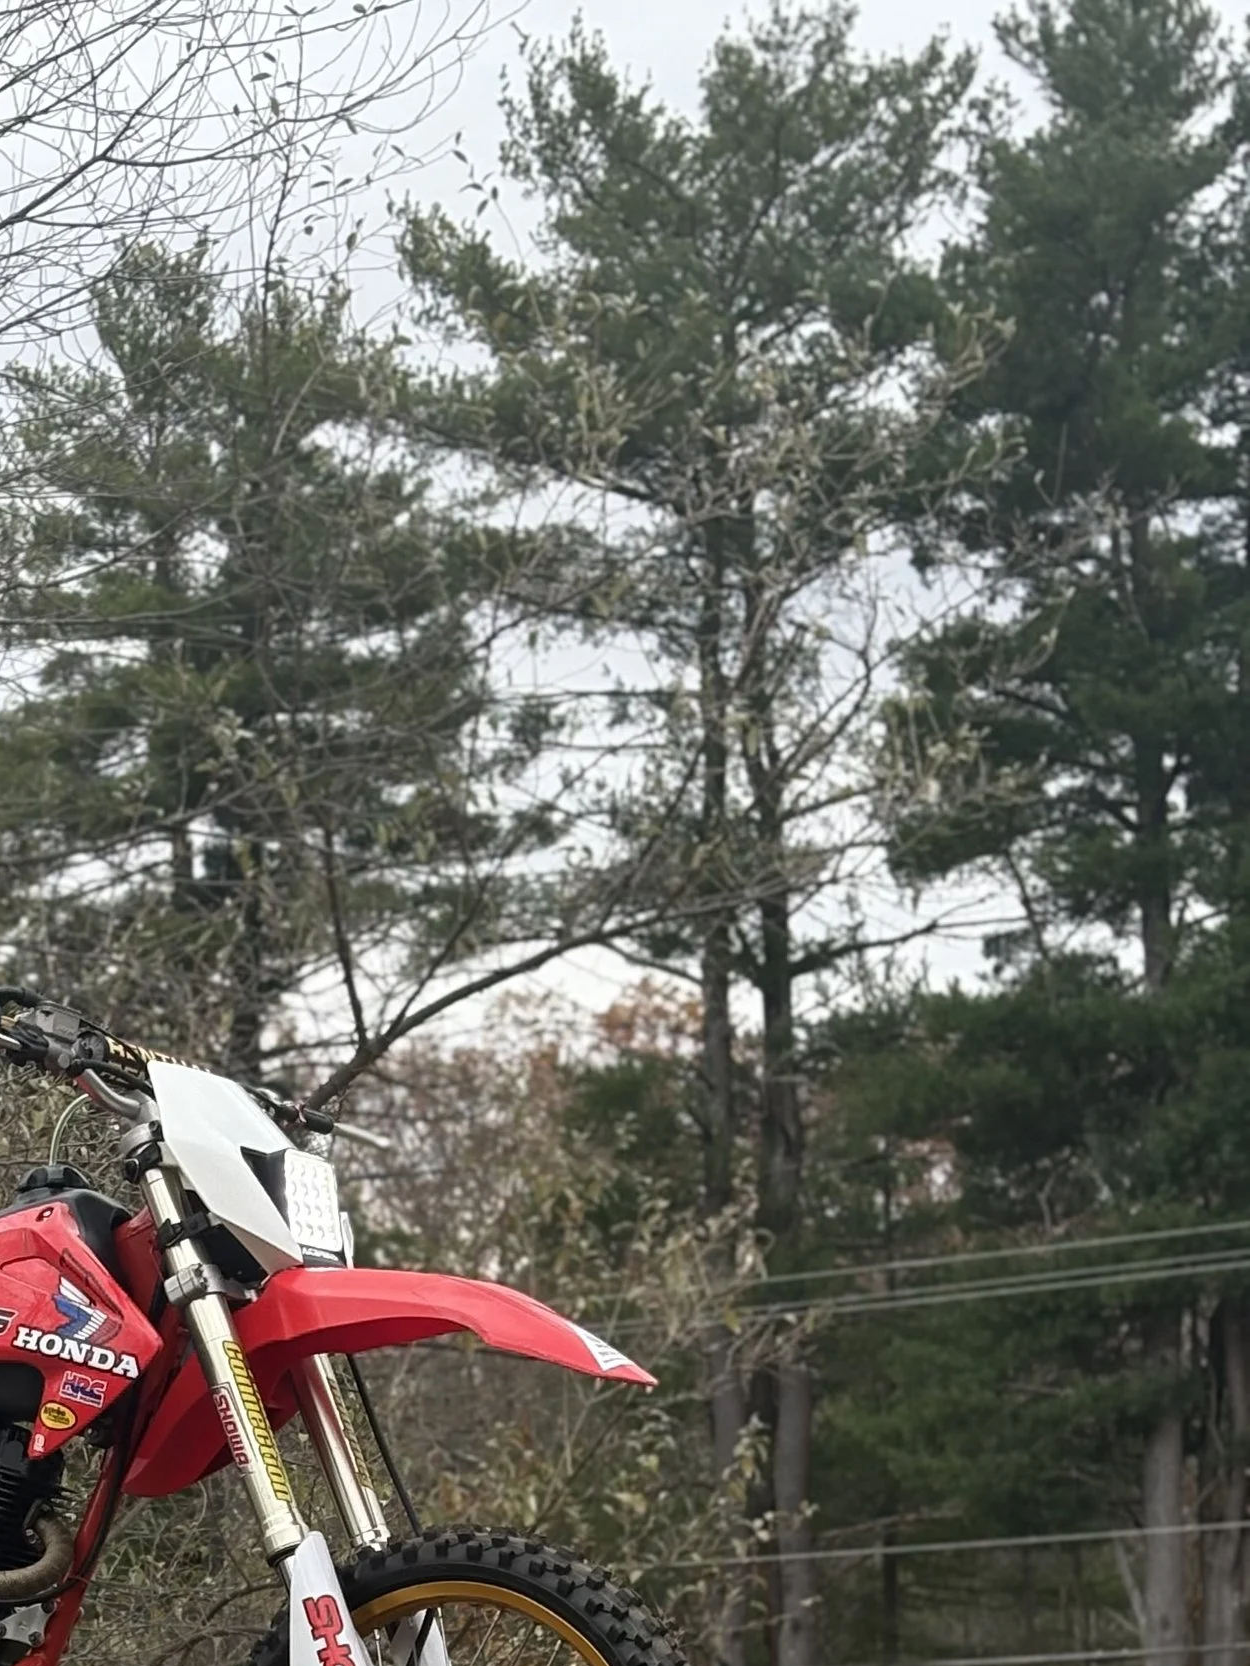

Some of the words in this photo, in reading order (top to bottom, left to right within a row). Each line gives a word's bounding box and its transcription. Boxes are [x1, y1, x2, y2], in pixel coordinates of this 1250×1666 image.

[12, 1326, 139, 1379] HONDA
[60, 1371, 107, 1402] HRC
[213, 1391, 251, 1467] SHOWA
